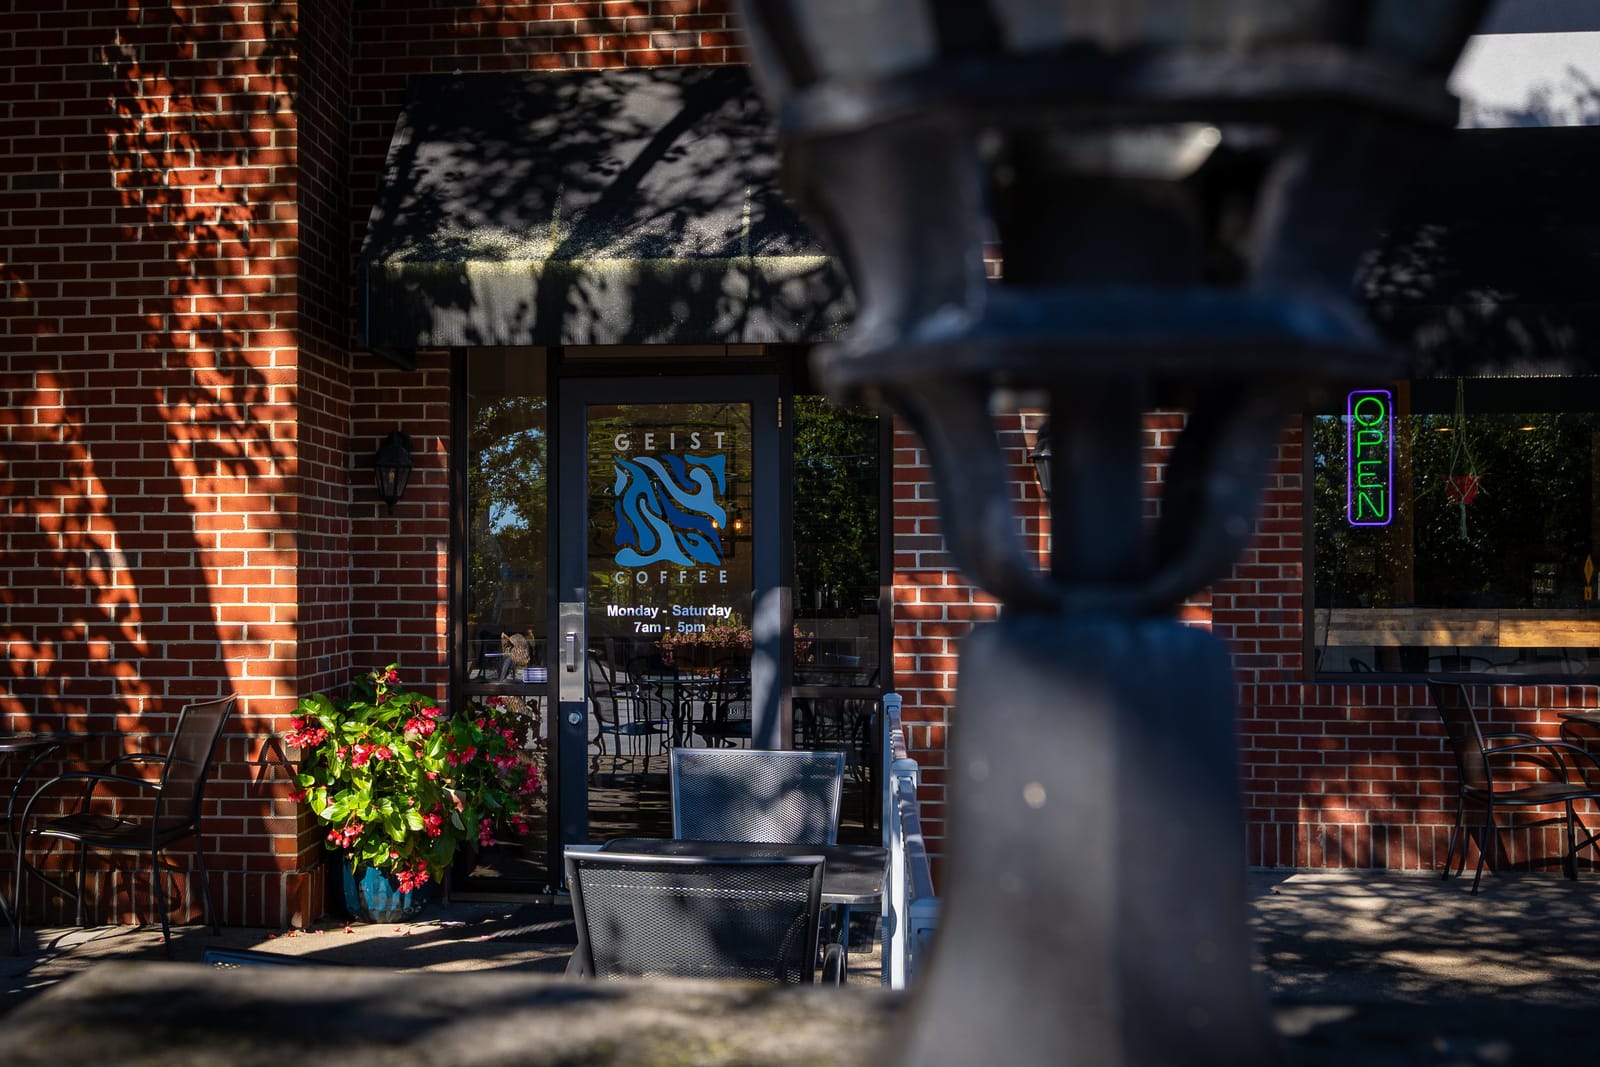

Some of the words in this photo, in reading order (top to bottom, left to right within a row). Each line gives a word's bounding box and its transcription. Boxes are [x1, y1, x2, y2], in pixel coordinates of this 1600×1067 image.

[614, 432, 725, 450] GEIST
[1355, 397, 1385, 518] OPEN
[614, 571, 728, 584] COFFEE
[607, 604, 659, 617] Monday
[672, 604, 732, 617] Saturday
[634, 622, 662, 633] 7am
[677, 622, 705, 635] 5pm
